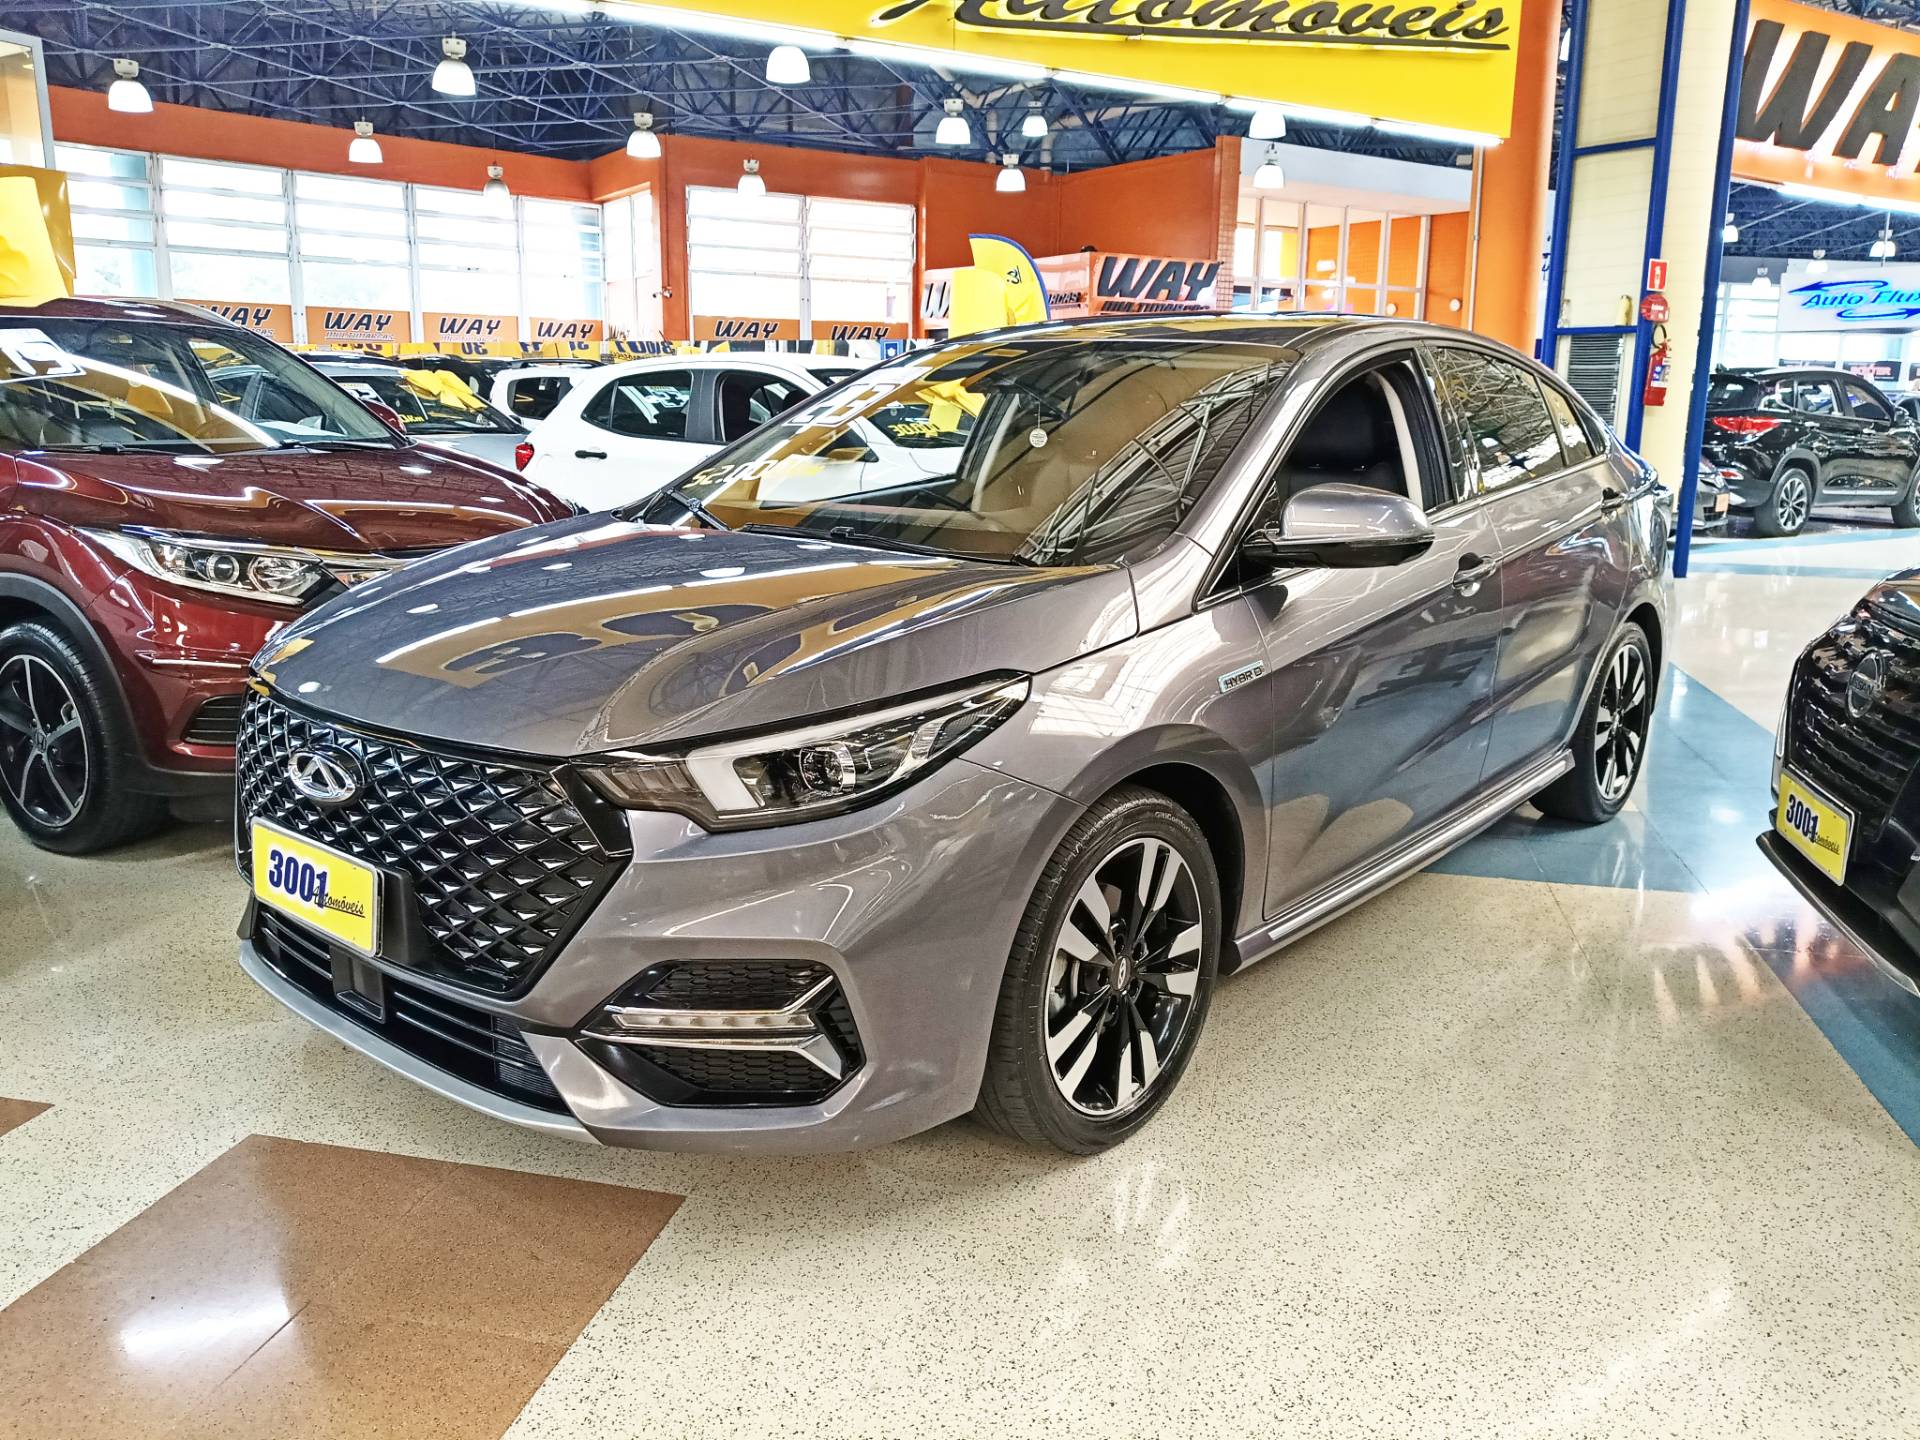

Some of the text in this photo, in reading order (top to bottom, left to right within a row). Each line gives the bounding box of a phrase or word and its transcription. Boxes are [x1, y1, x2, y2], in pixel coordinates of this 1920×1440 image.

[1735, 18, 1920, 171] WA
[1097, 256, 1221, 301] WAY
[1801, 292, 1864, 307] Auto
[324, 311, 394, 332] WAY
[439, 317, 501, 335] WAY
[537, 321, 594, 339] WAY
[714, 320, 779, 339] WAY
[831, 325, 890, 340] WAY
[1224, 666, 1264, 689] HYBRD
[1786, 794, 1819, 843] 3001
[269, 849, 328, 909] 3001
